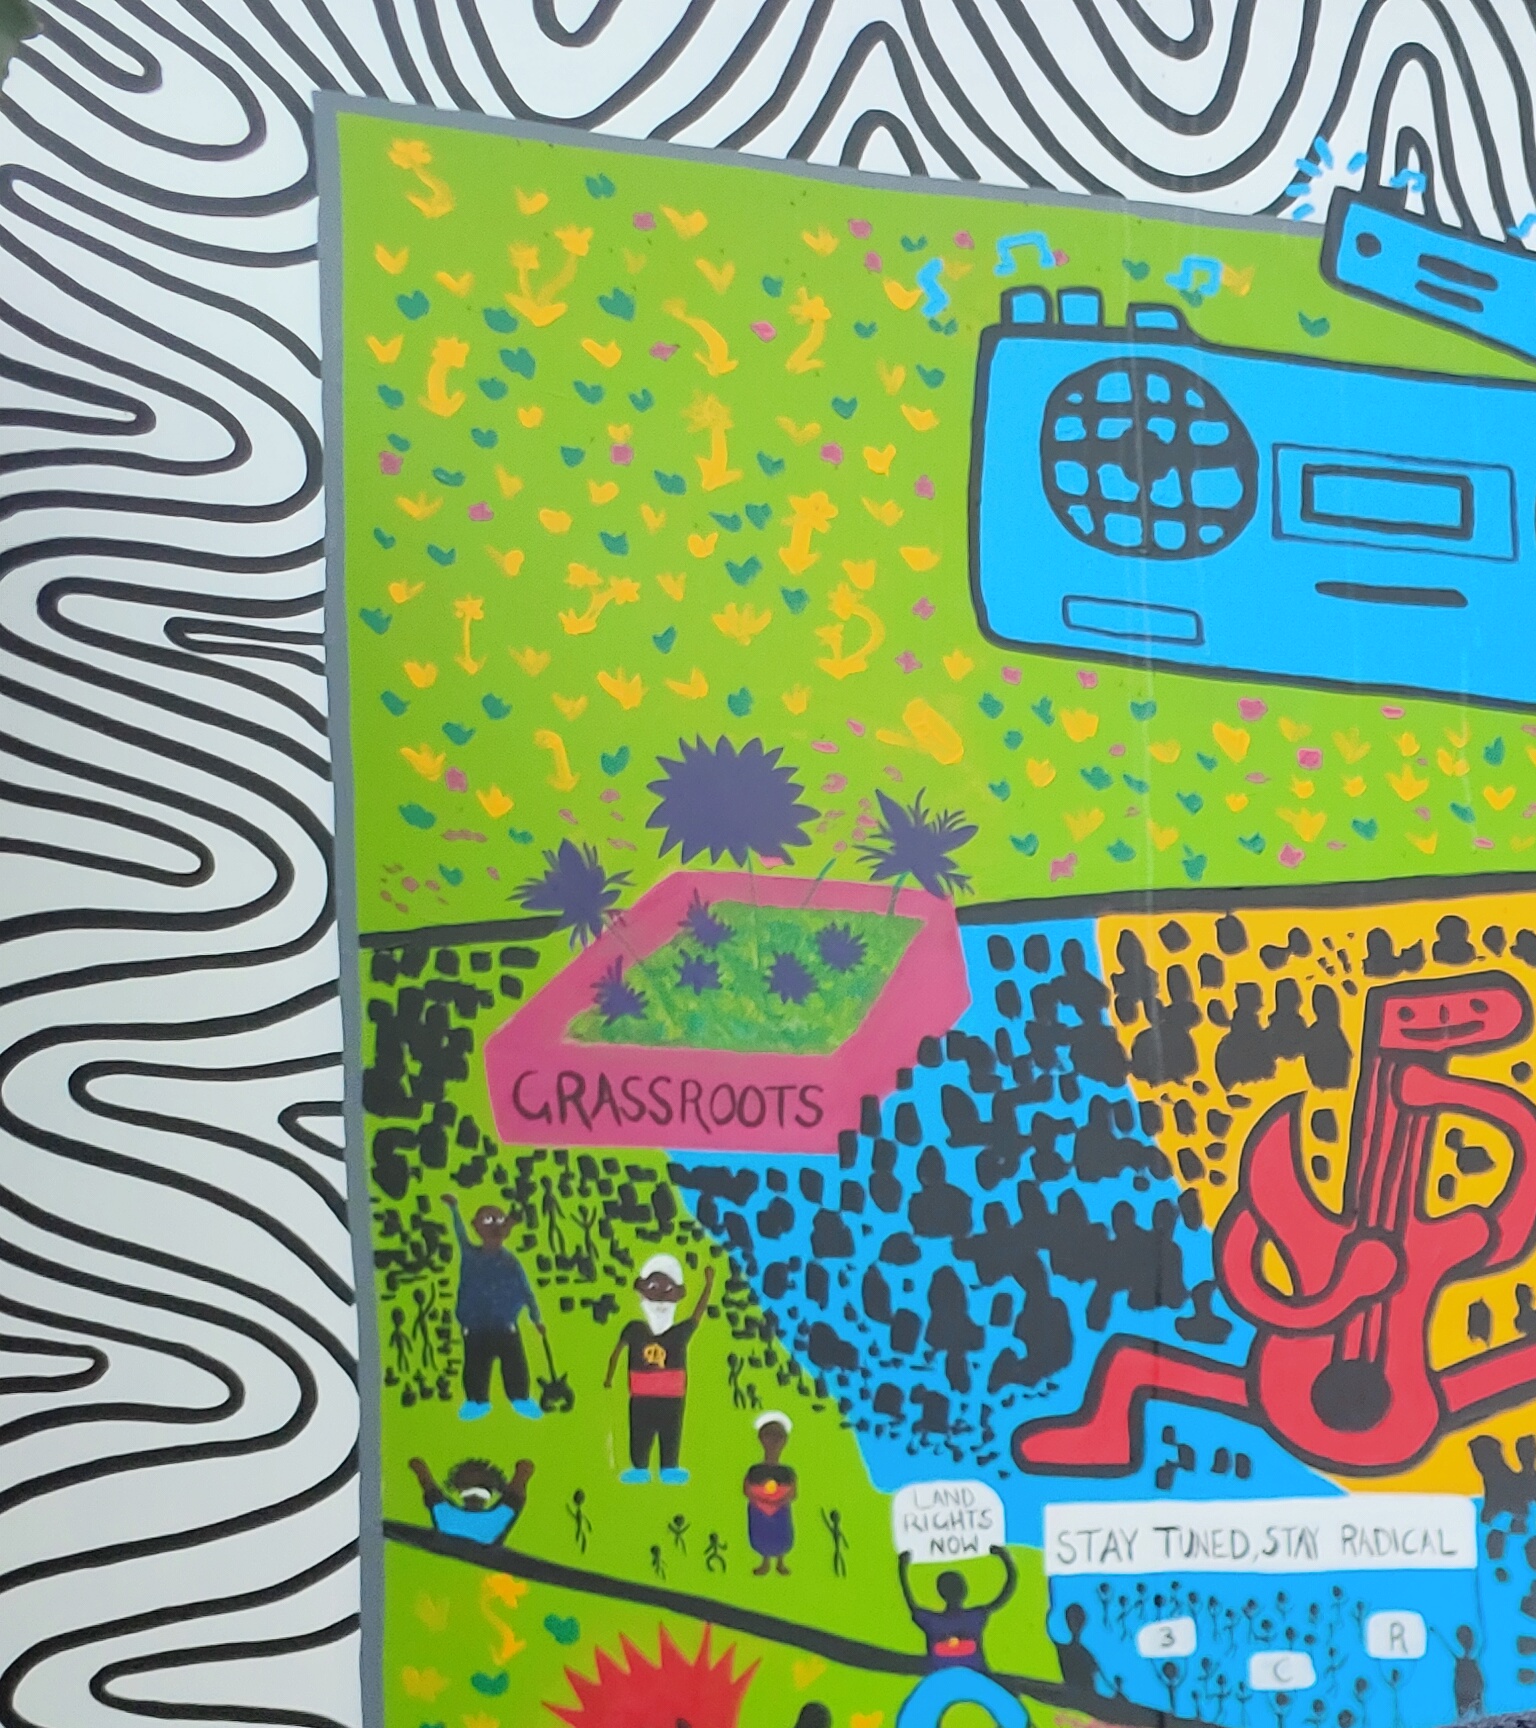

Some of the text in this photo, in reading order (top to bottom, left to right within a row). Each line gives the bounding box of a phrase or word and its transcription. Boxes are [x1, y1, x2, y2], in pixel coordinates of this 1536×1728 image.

[511, 1069, 825, 1133] GRASSROOTS
[913, 1487, 976, 1510] LAND
[904, 1508, 993, 1533] RIGHTS
[930, 1534, 979, 1556] NOW
[1057, 1528, 1139, 1565] STAY
[1340, 1524, 1458, 1557] RADICAL
[1159, 1626, 1177, 1649] 3
[1389, 1620, 1409, 1655] R
[1271, 1658, 1292, 1684] C
